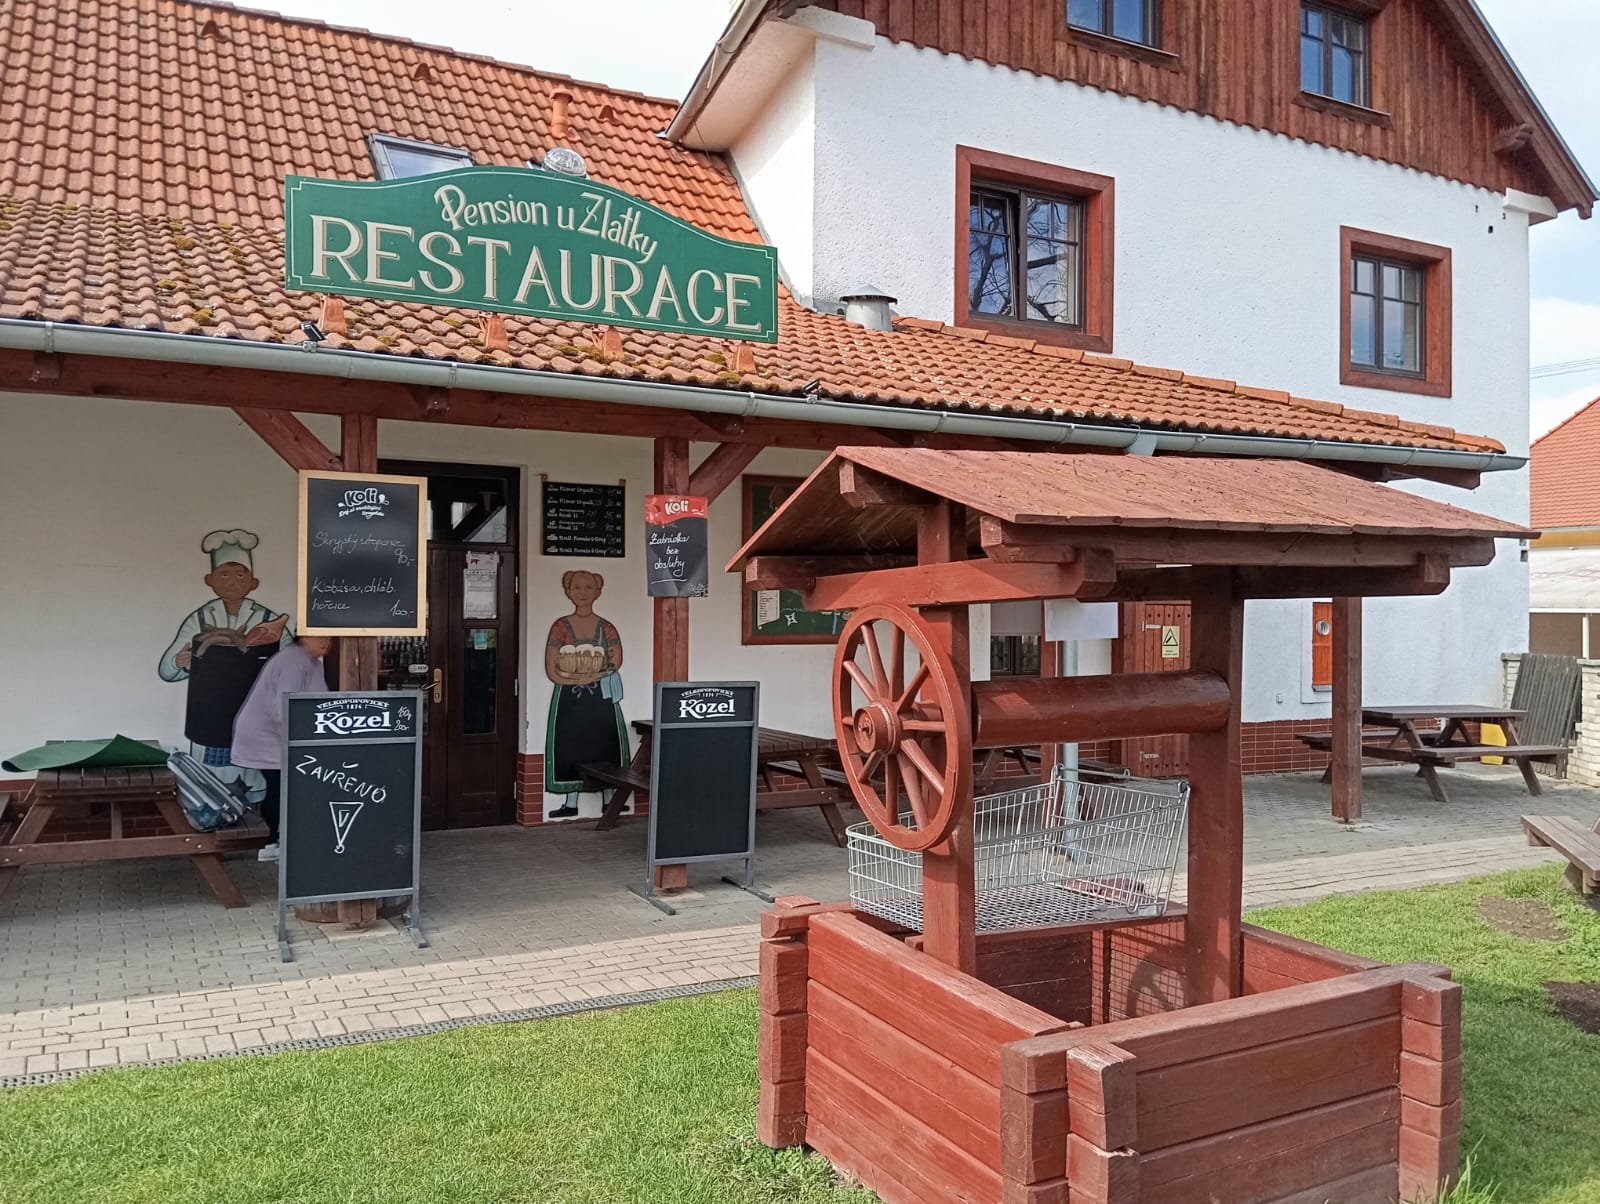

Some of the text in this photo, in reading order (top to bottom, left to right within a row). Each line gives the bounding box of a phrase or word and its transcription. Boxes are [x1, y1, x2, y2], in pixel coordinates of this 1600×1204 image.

[434, 184, 658, 265] Pension u Zlatky
[310, 214, 763, 332] RESTAURACE
[654, 556, 685, 577] obsluhy
[679, 699, 736, 719] Kozel
[314, 711, 392, 735] Kozel
